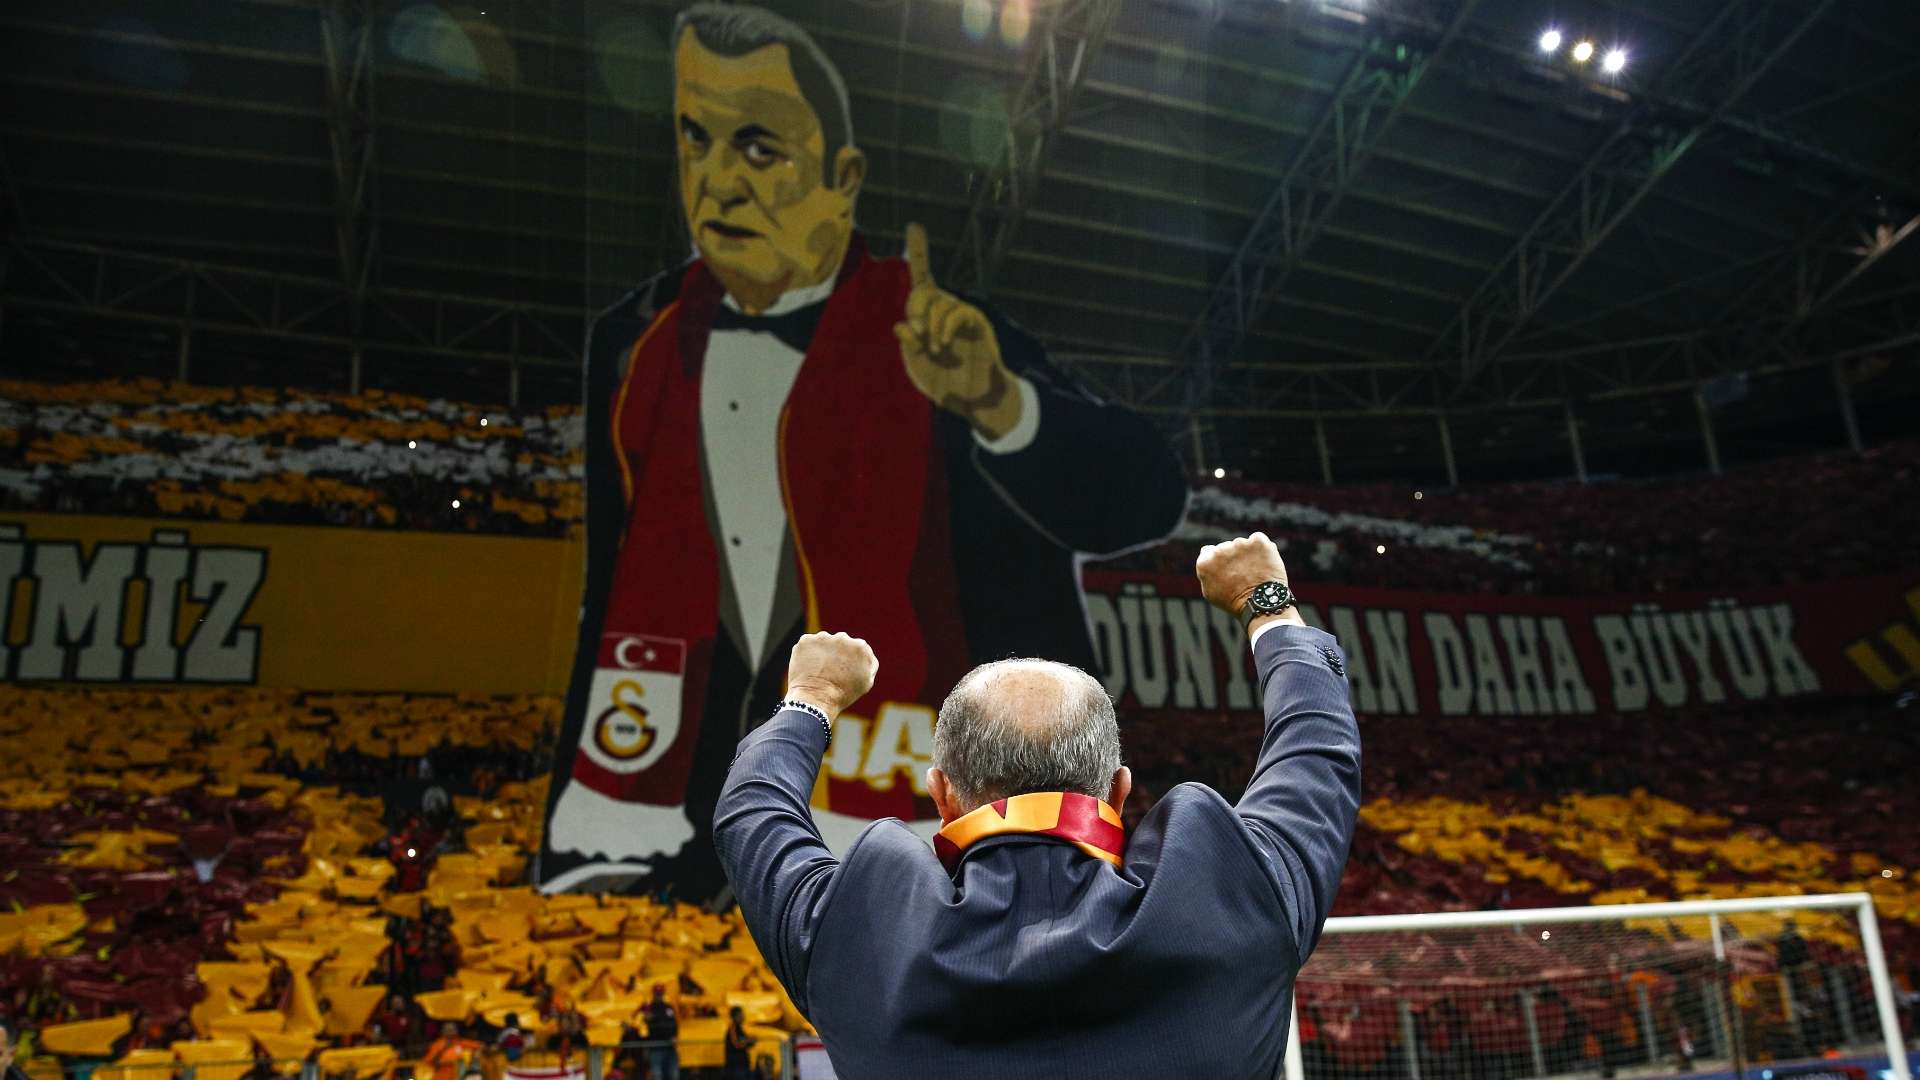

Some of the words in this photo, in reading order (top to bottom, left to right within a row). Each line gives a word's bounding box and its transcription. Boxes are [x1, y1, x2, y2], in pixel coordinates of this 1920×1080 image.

[1085, 582, 1420, 715] DÜNYAN
[1422, 611, 1598, 714] DAHA
[1593, 598, 1823, 711] BÜYÜK
